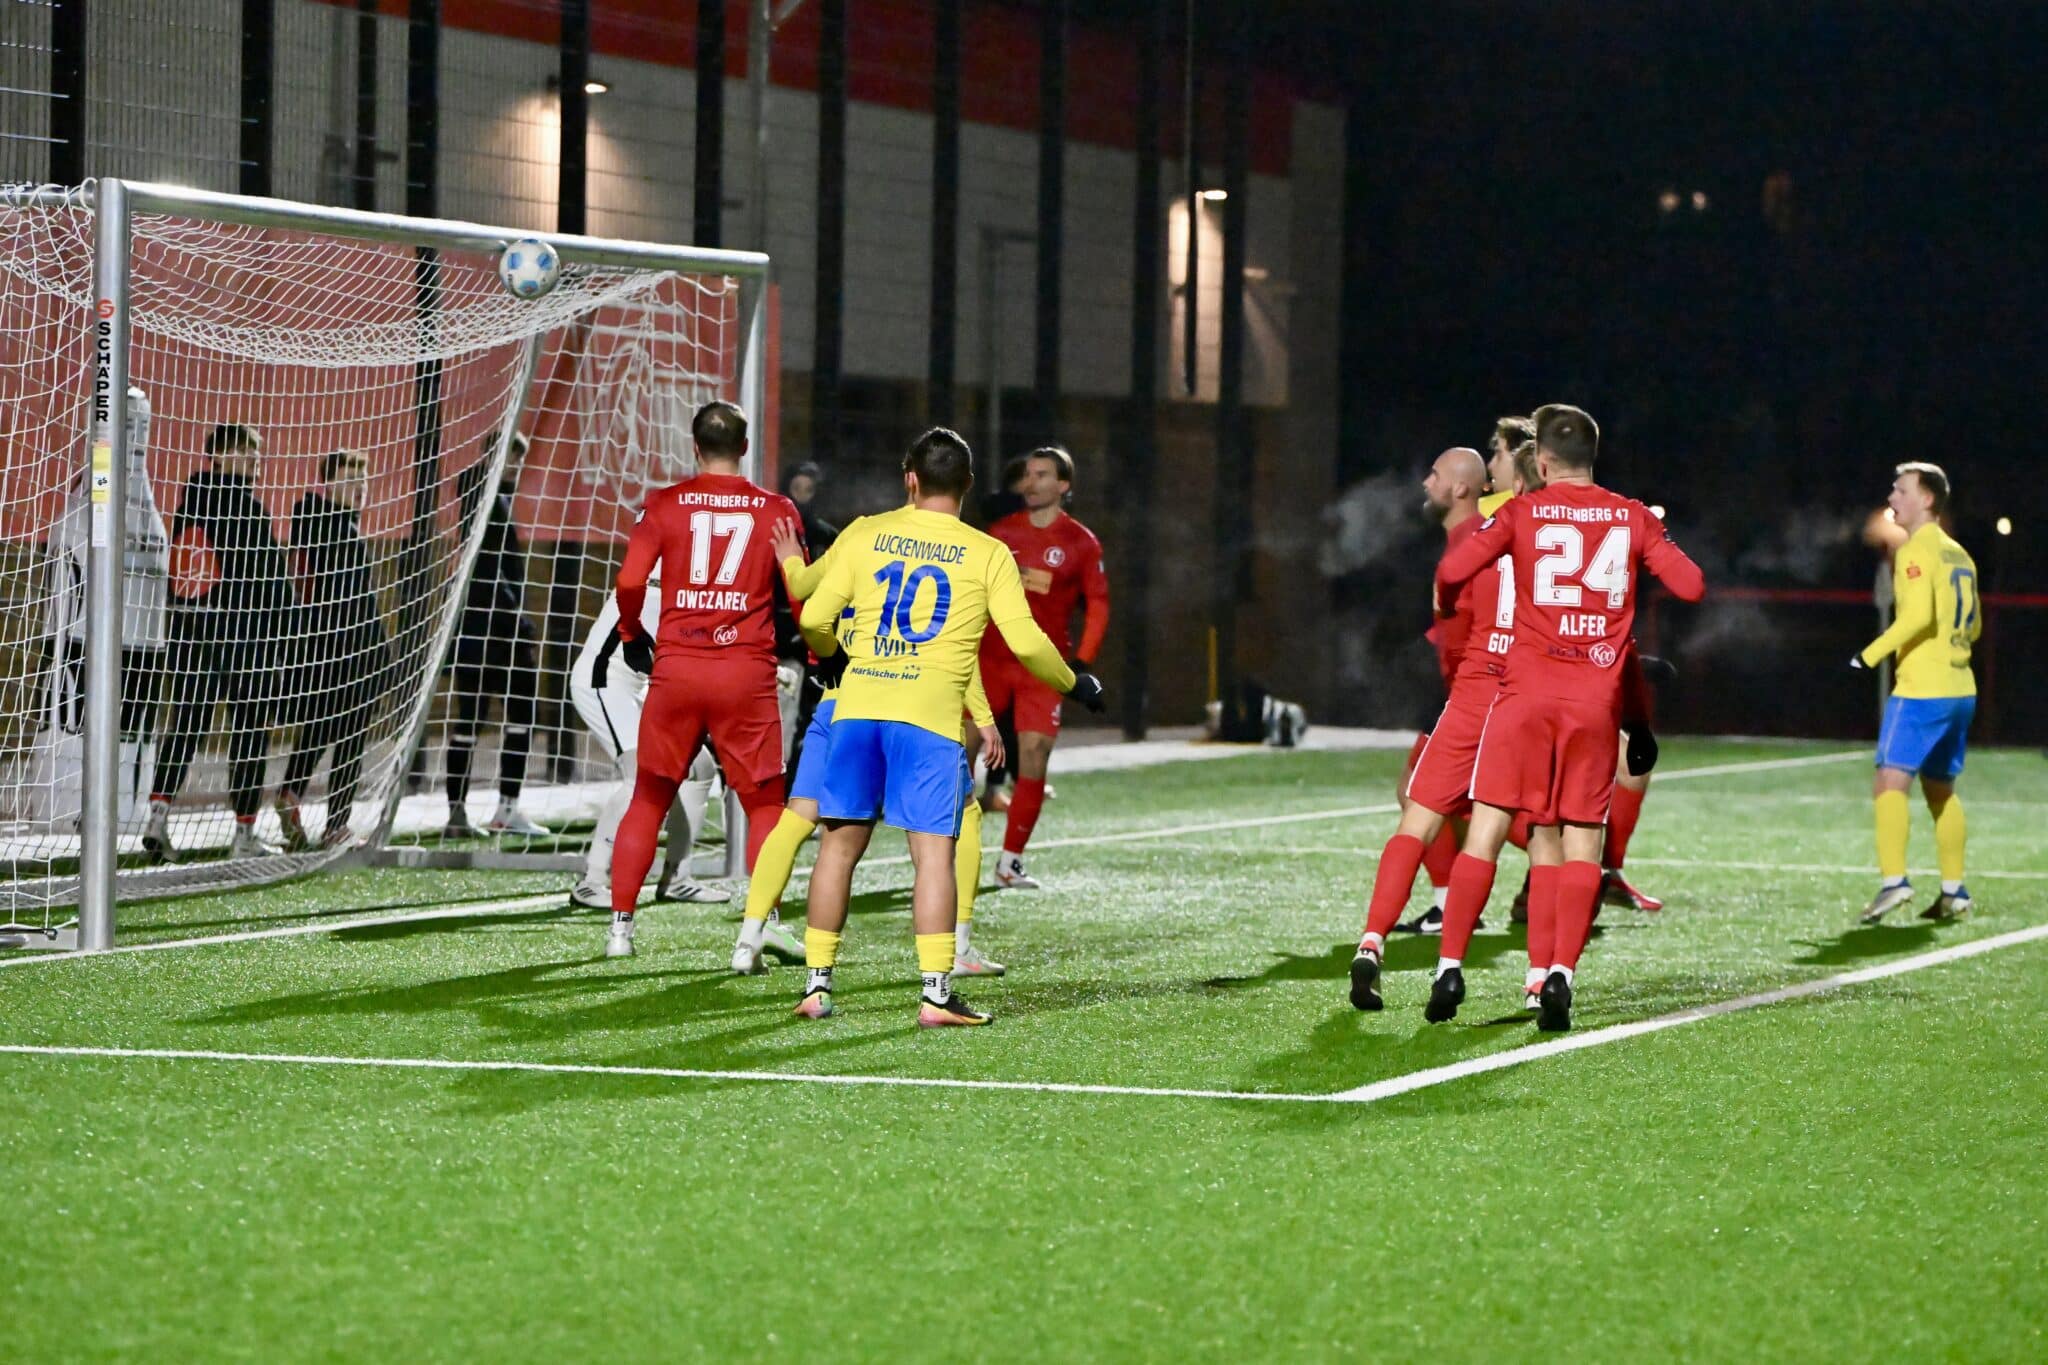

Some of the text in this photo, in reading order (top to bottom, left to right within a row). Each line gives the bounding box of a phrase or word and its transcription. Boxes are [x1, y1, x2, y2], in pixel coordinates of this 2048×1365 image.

[95, 321, 111, 422] SCHÄPER
[678, 492, 766, 508] LICHTENBERG 47
[1532, 504, 1629, 522] LICHTENBERG 47
[689, 510, 755, 585] 17
[873, 533, 967, 564] LUCKENWALDE
[1534, 524, 1630, 608] 24
[676, 589, 749, 611] OWCZAREK
[873, 560, 952, 643] 10
[1495, 553, 1516, 629] 1
[1558, 613, 1607, 637] ALFER
[851, 667, 920, 680] Märkischer Hof
